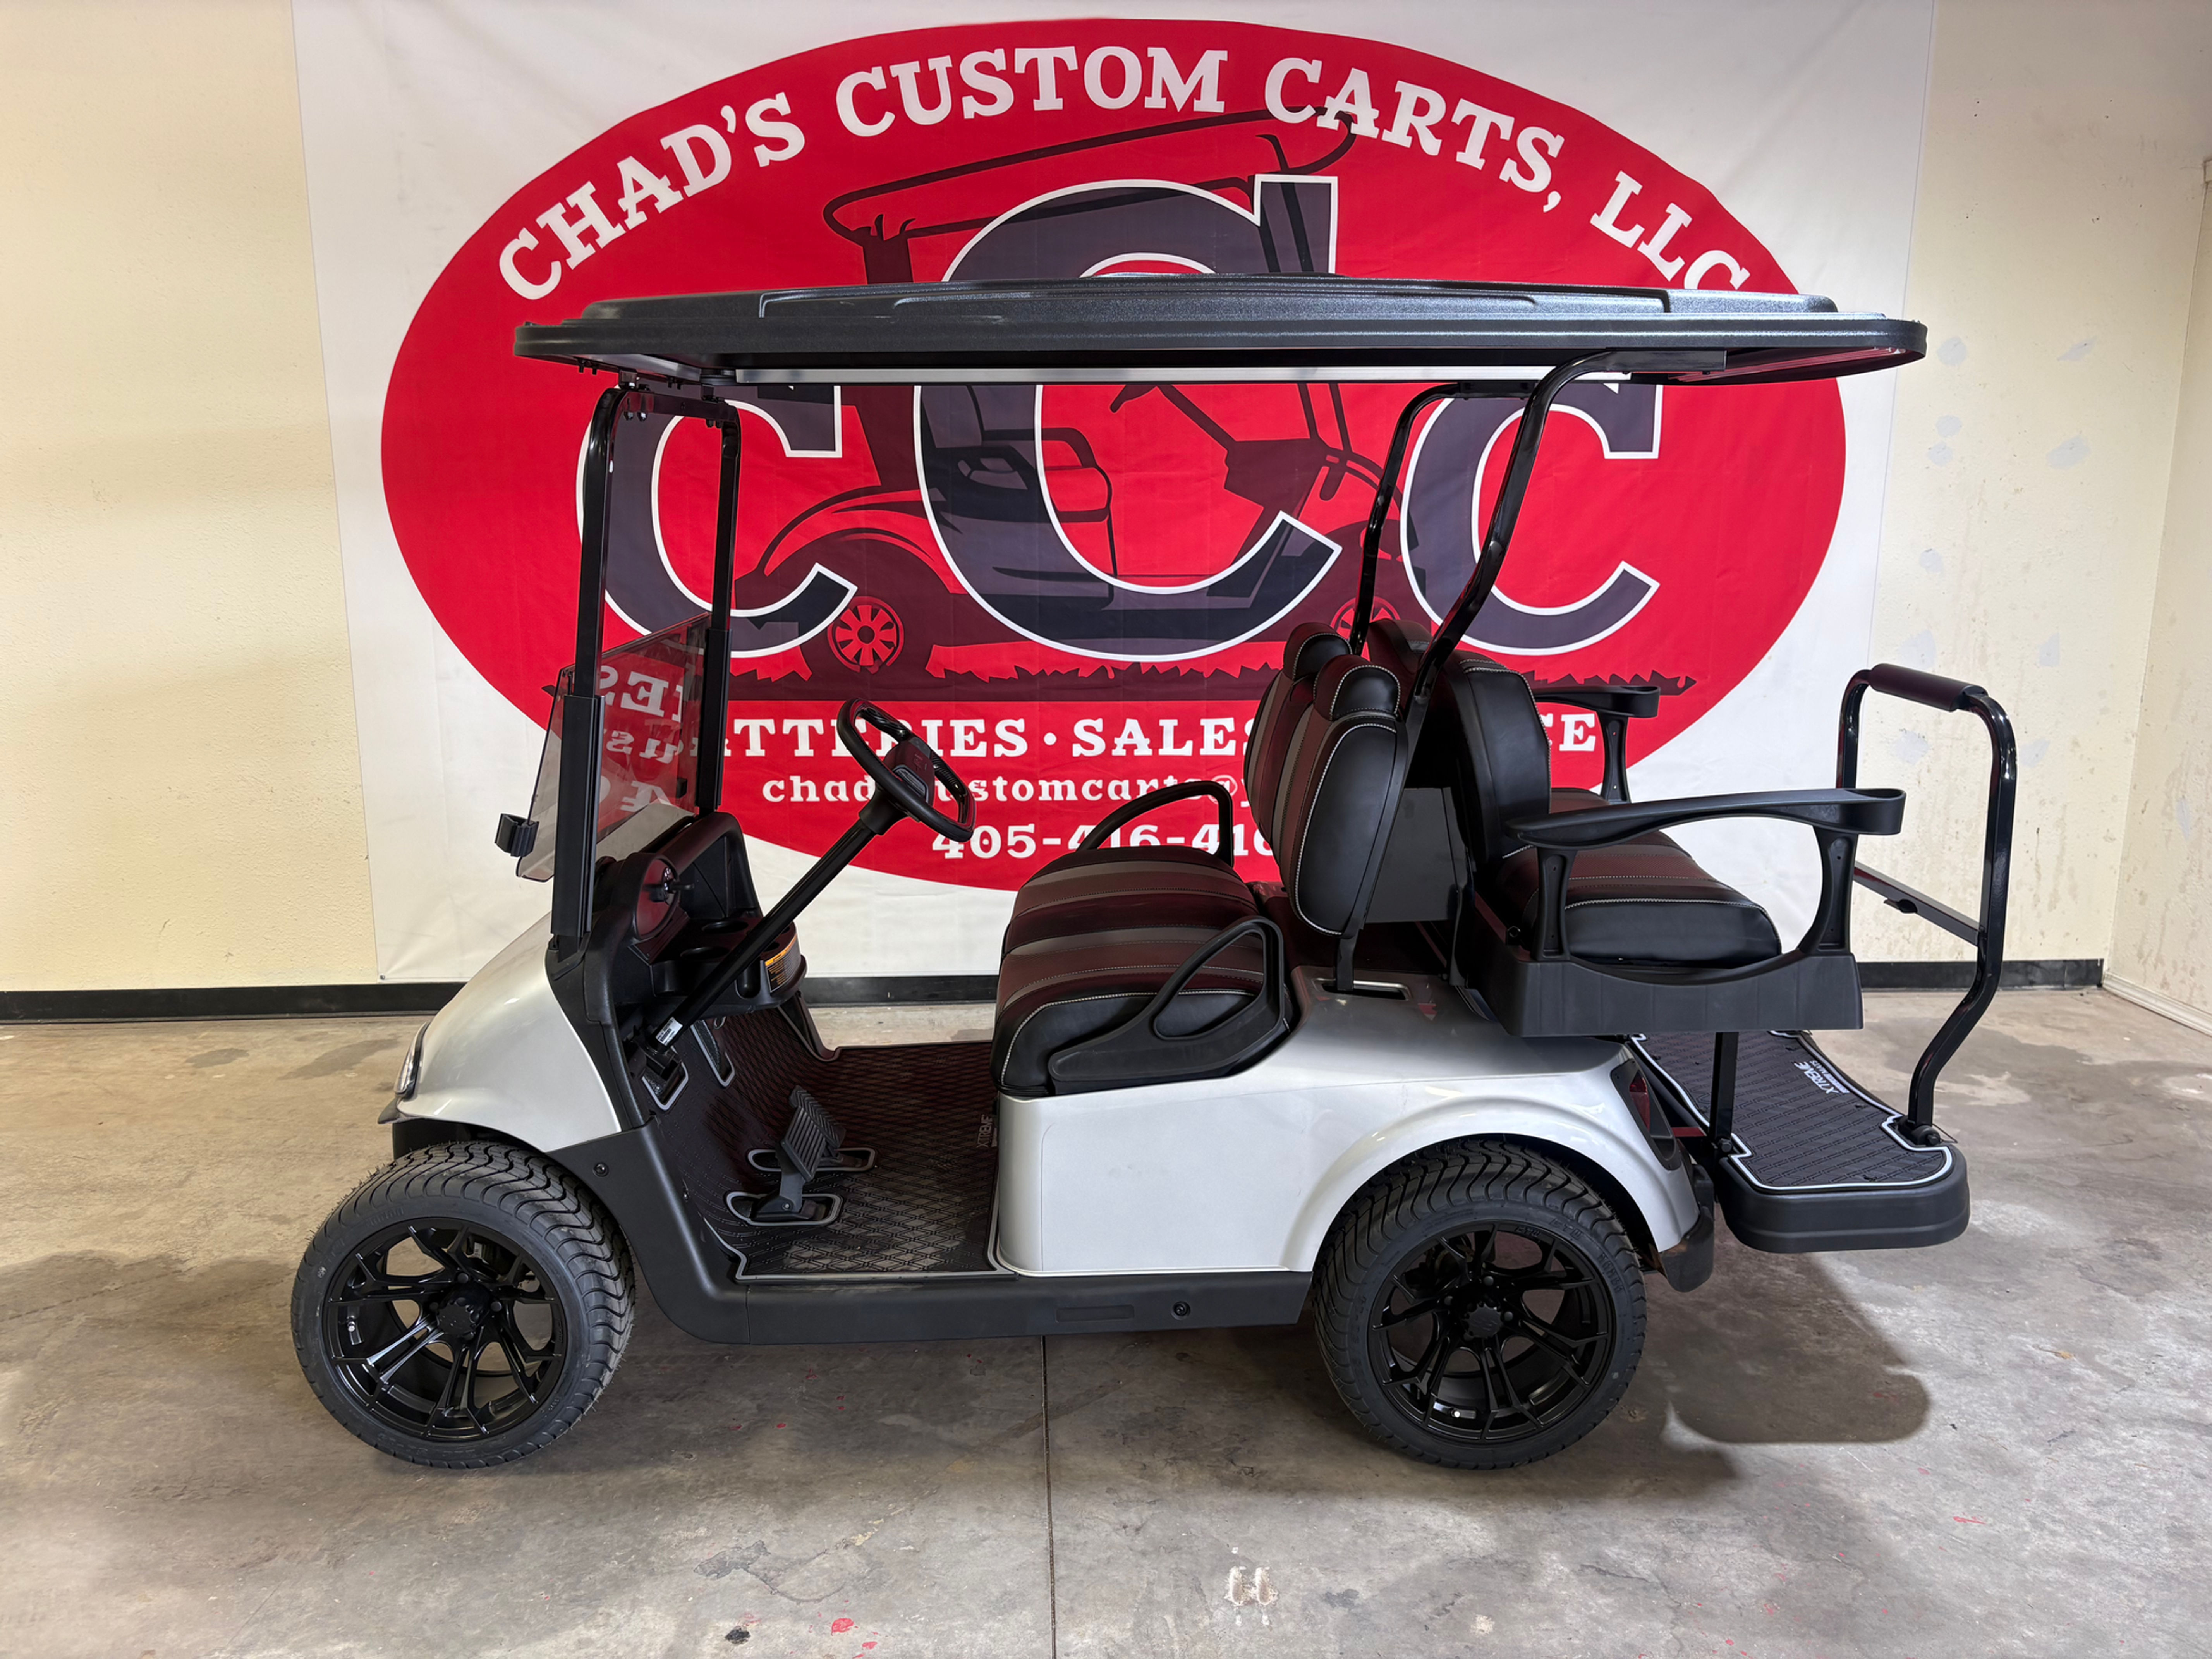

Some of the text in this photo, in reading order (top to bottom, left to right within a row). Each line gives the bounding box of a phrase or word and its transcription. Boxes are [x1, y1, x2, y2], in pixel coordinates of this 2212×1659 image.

[499, 92, 805, 300] CHAD'S
[836, 46, 1228, 137] CUSTOM
[1264, 57, 1565, 213] CARTS,
[690, 717, 1028, 757] TTEIES
[1072, 717, 1255, 757] SALE
